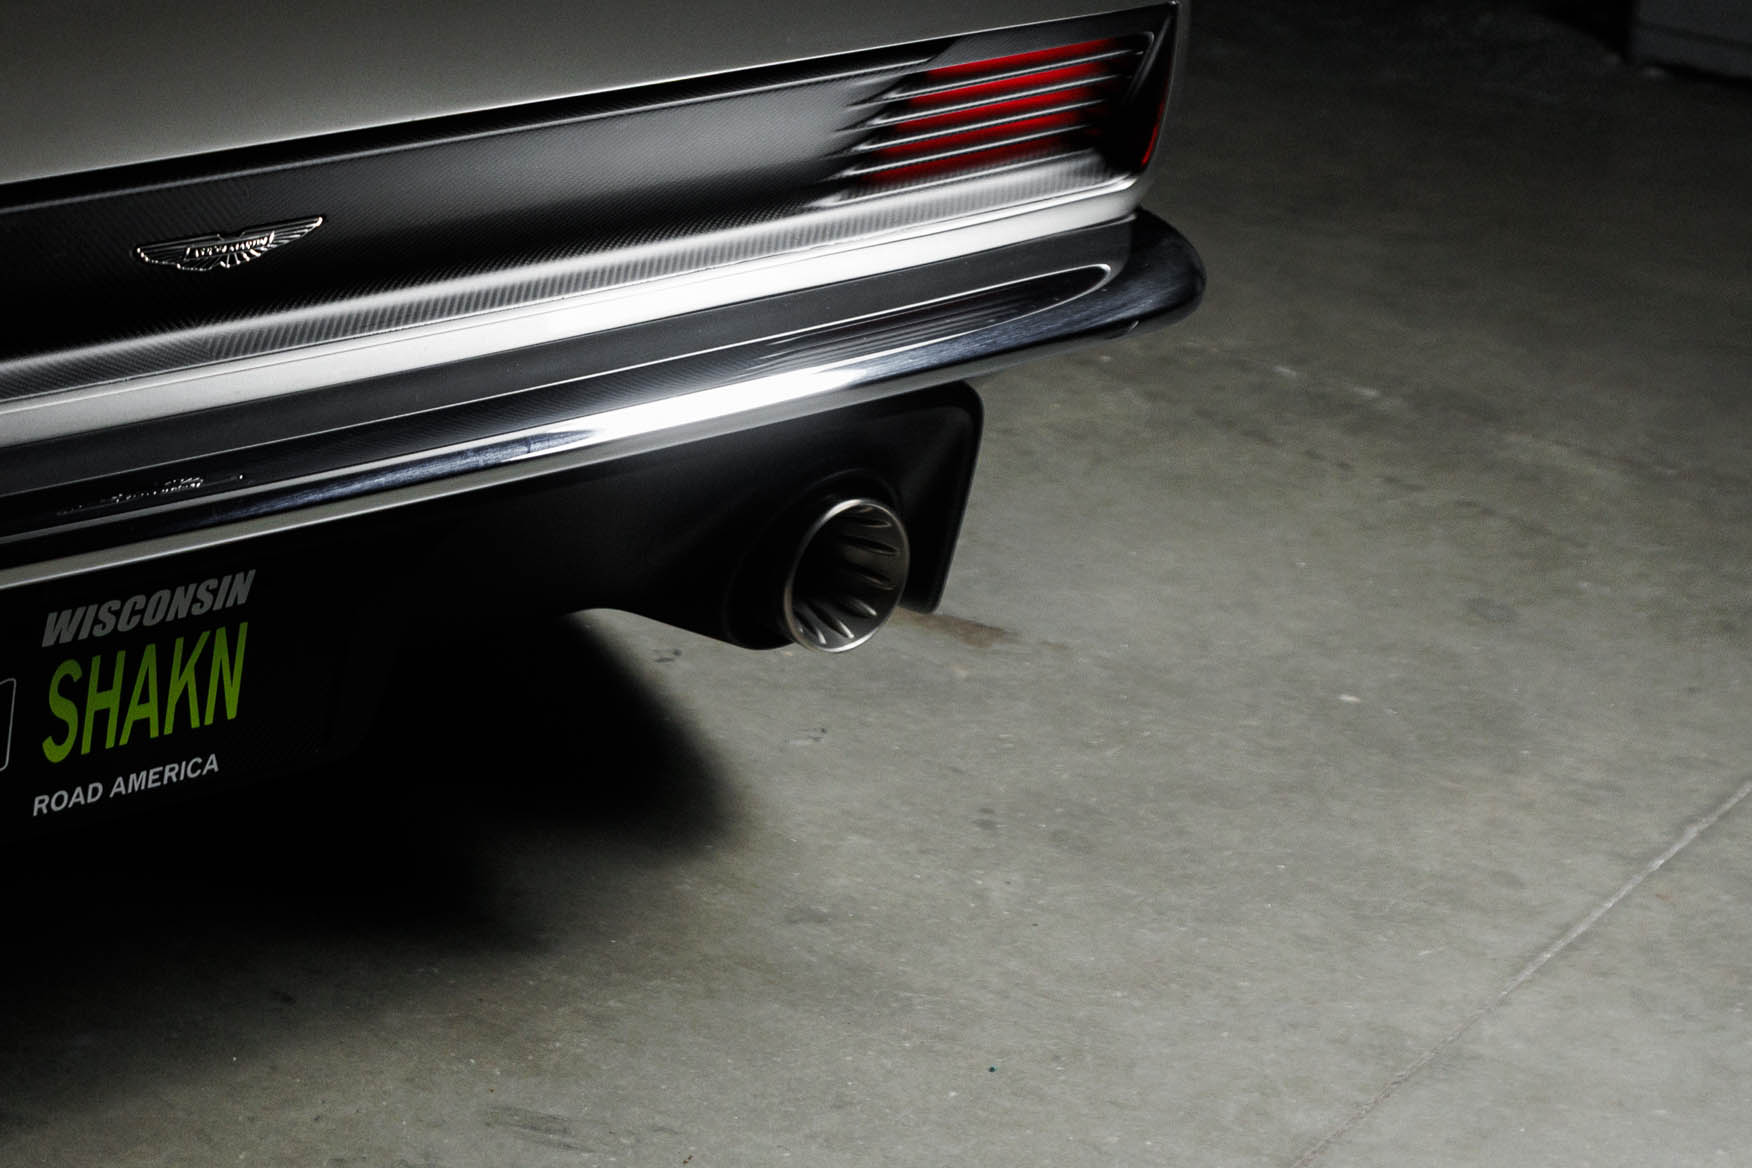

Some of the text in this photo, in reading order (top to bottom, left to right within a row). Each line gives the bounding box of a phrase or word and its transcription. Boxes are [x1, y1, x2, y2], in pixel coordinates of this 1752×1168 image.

[41, 569, 256, 647] WISCONSIN
[42, 622, 249, 763] SHAKN
[33, 753, 219, 817] ROAD AMERICA
